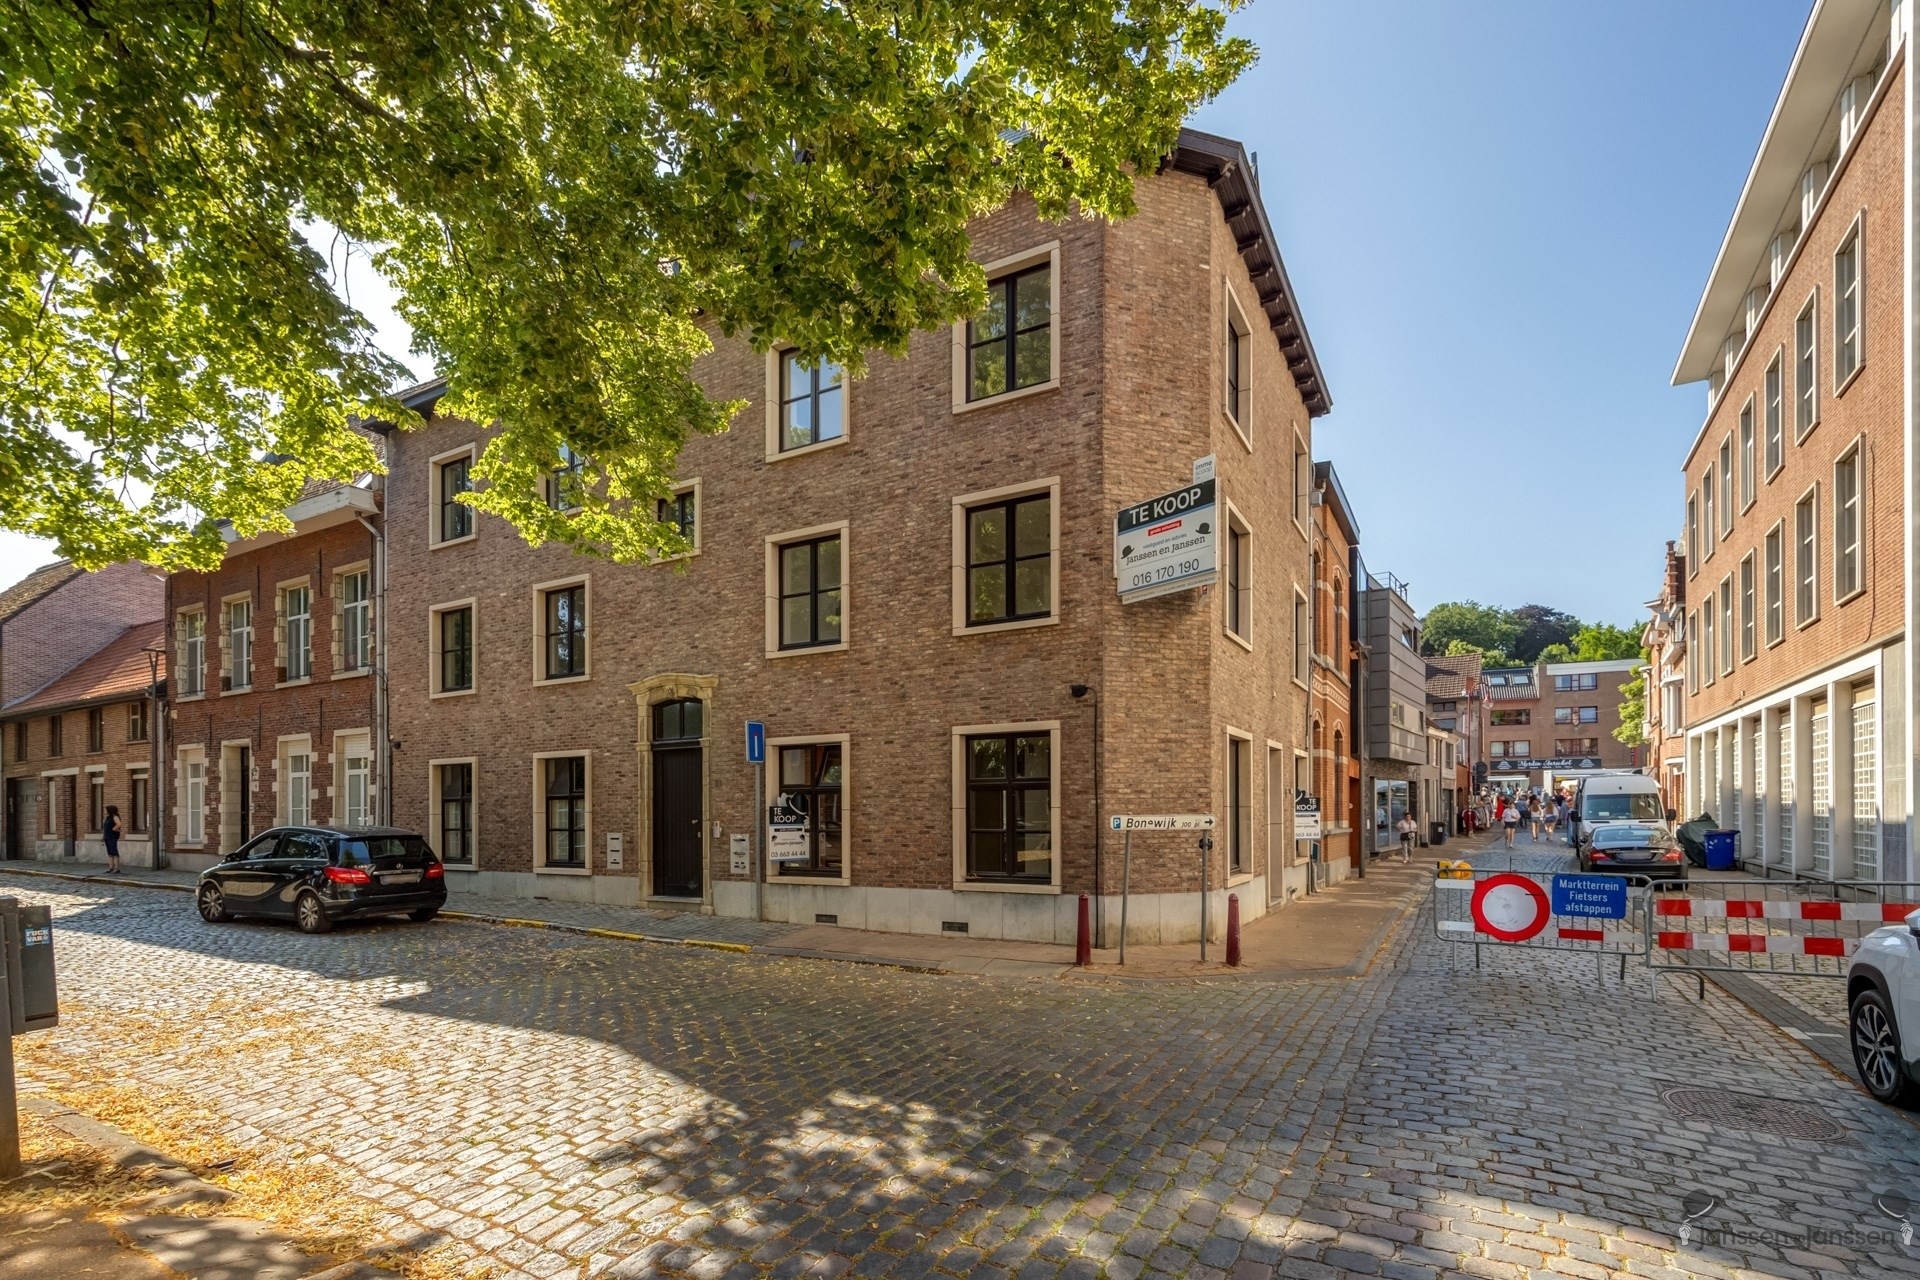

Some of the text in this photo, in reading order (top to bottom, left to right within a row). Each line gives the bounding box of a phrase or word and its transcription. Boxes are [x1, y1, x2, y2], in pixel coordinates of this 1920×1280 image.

[1130, 487, 1202, 525] TE KOOP
[1126, 535, 1205, 565] Janssen en Janssen
[1132, 558, 1200, 586] 016 170 190
[1559, 878, 1619, 891] Marktterrein
[1569, 890, 1608, 903] Fietsers
[1565, 902, 1612, 915] afstappen
